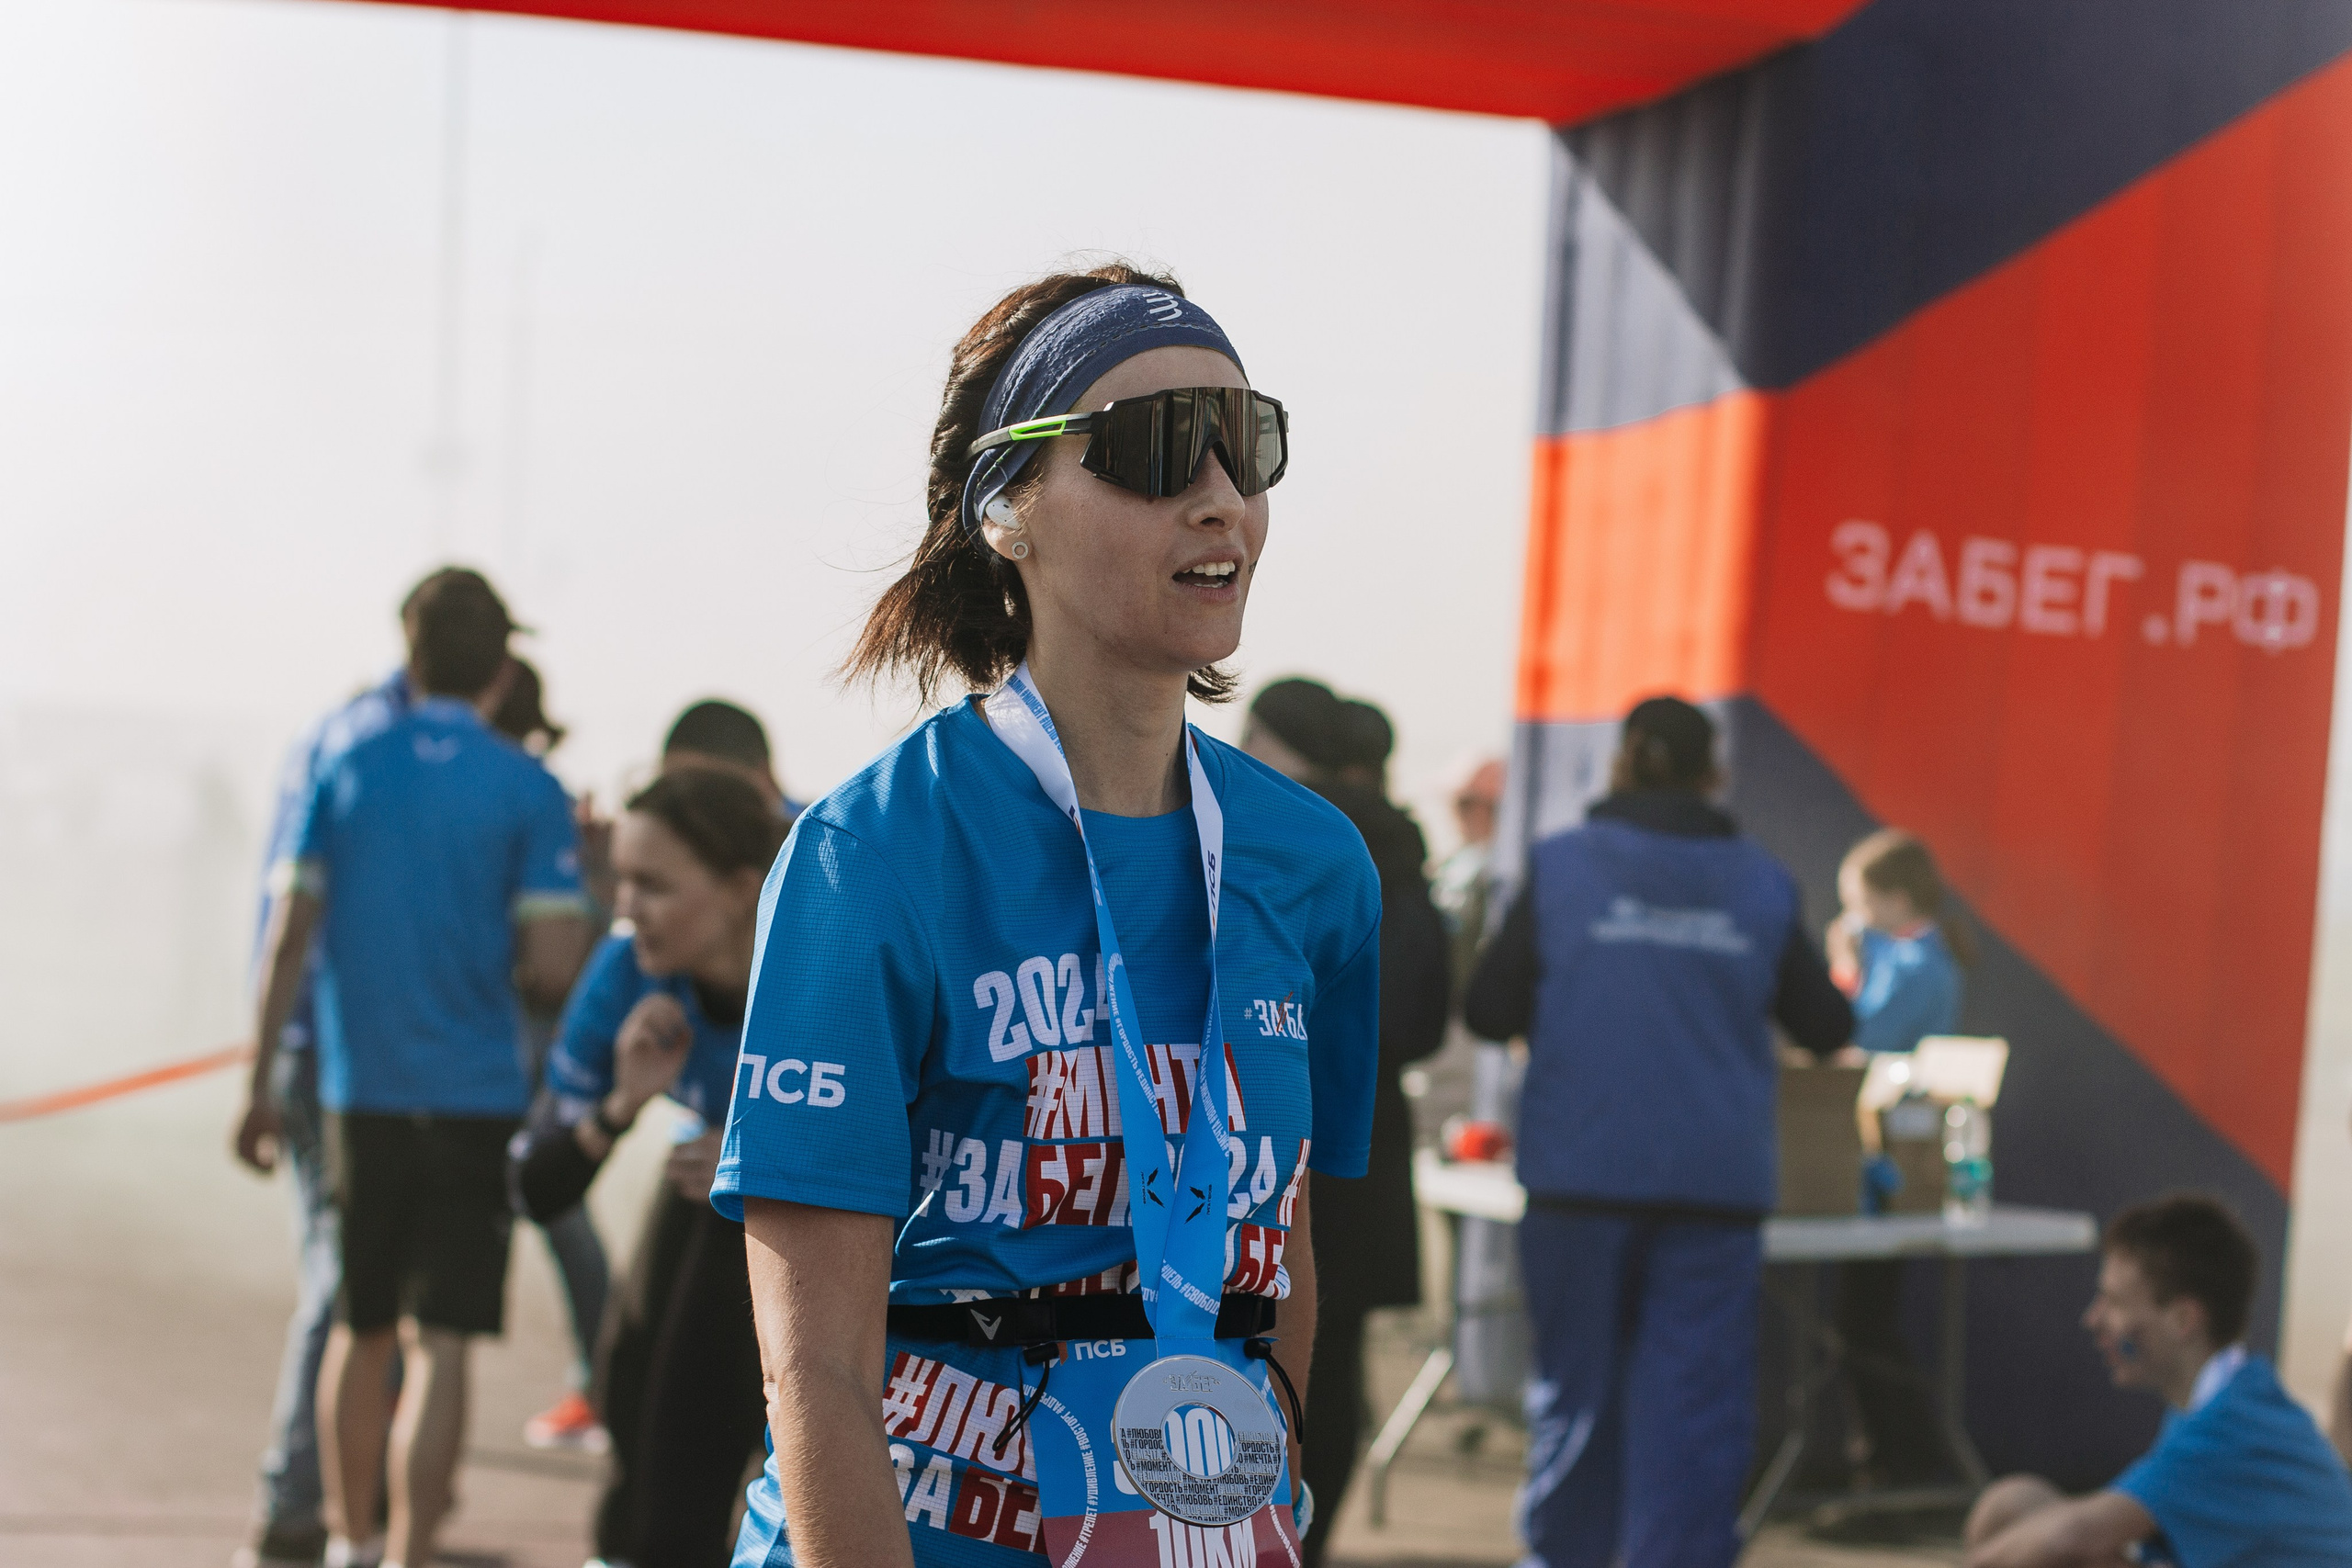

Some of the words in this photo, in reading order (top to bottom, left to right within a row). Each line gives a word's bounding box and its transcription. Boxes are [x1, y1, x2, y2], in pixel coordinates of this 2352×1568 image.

[1826, 519, 2320, 653] ЗАБЕГ.РФ
[740, 1054, 846, 1108] ПСБ
[1074, 1339, 1127, 1362] ПСБ
[1060, 1411, 1091, 1450] #ВОСТОРГ
[1136, 1461, 1171, 1472] #МОМЕНТ
[1244, 1453, 1273, 1464] #МЕЧТА
[1081, 1450, 1099, 1506] #УДИВЛЕНИЕ
[1183, 1483, 1218, 1495] #МОМЕНТ
[1176, 1494, 1213, 1506] #ЛЮБОВЬ
[1214, 1495, 1258, 1506] #ЕДИНСТВО
[1078, 1506, 1098, 1544] #ТРЕПЕТ
